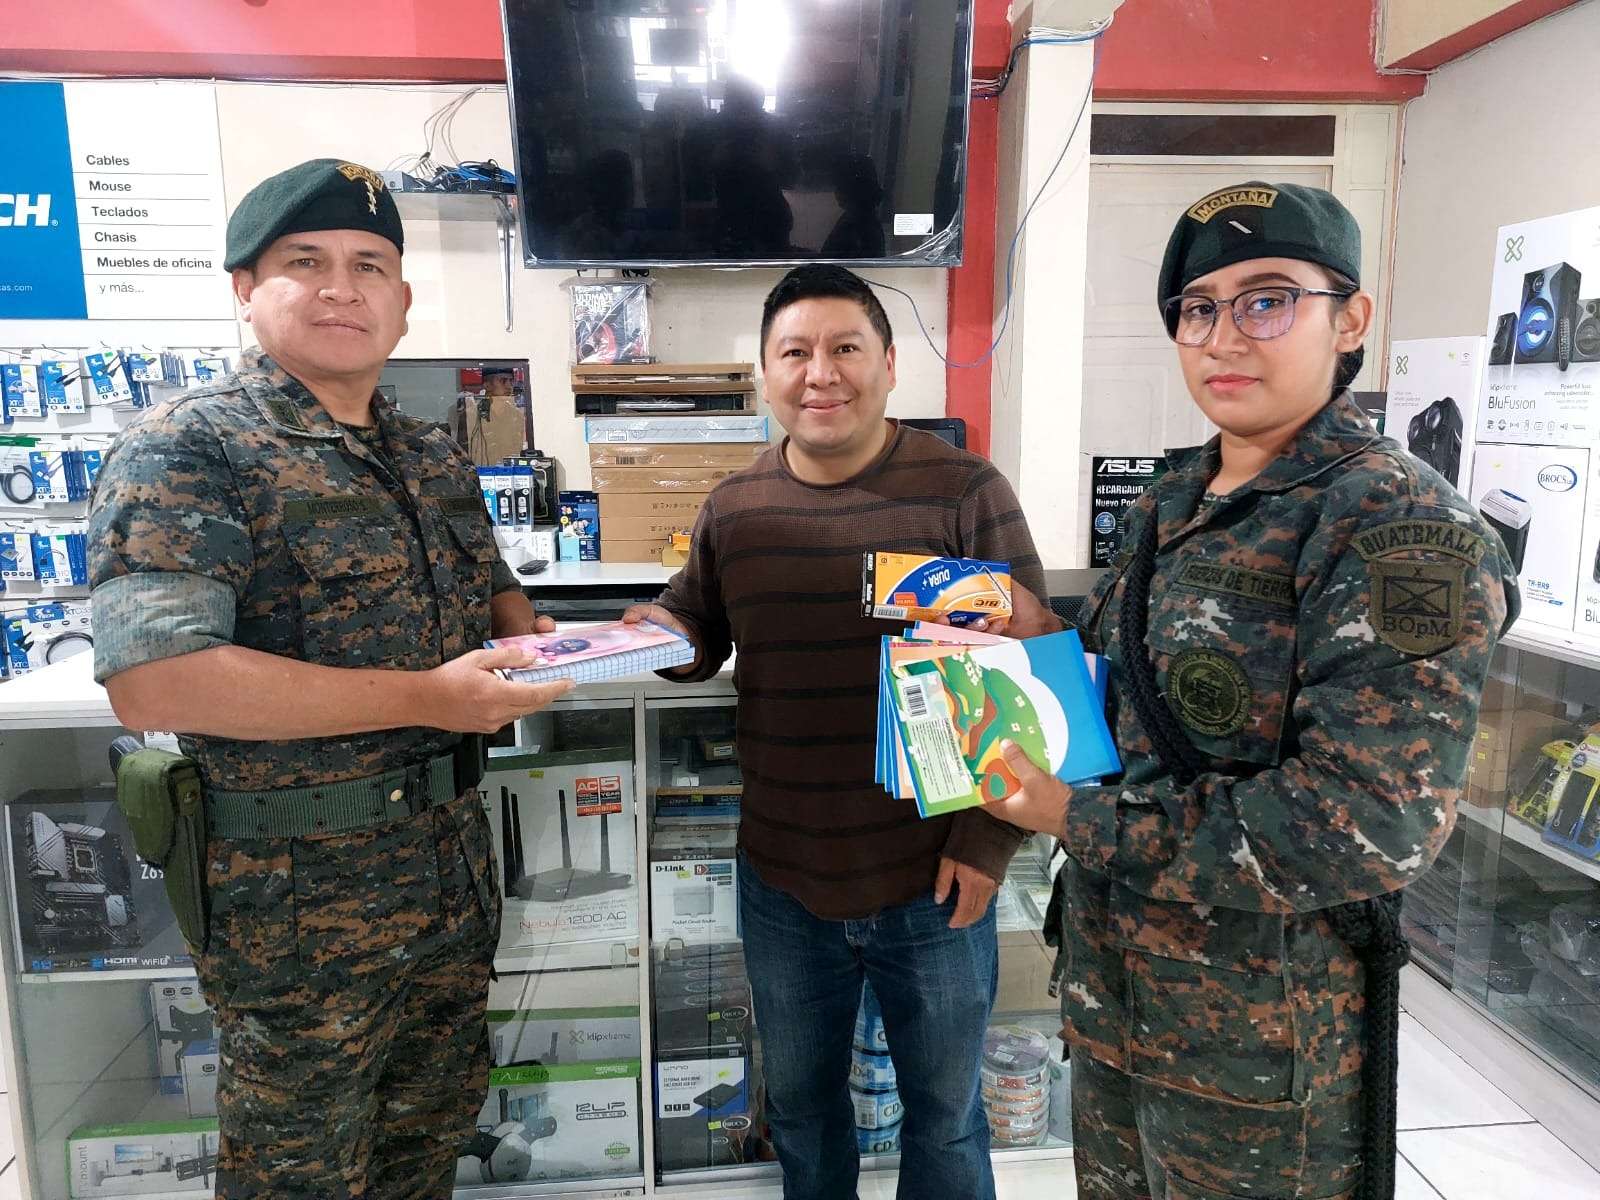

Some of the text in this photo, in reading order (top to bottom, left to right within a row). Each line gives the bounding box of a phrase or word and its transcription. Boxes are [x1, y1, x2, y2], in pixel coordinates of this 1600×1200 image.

[86, 154, 130, 166] Cables
[88, 180, 132, 192] Mouse
[91, 205, 149, 218] Teclados
[94, 230, 137, 243] Chasis
[97, 256, 213, 269] Muebles de oficina
[0, 283, 33, 293] as.com
[99, 284, 106, 295] y
[1488, 395, 1536, 410] BluFusion
[1097, 459, 1155, 473] ASUS
[1095, 498, 1119, 507] Nuevo
[973, 598, 1000, 608] BIC
[577, 781, 598, 792] AC
[655, 864, 686, 872] D-Link
[104, 957, 137, 965] HDMI
